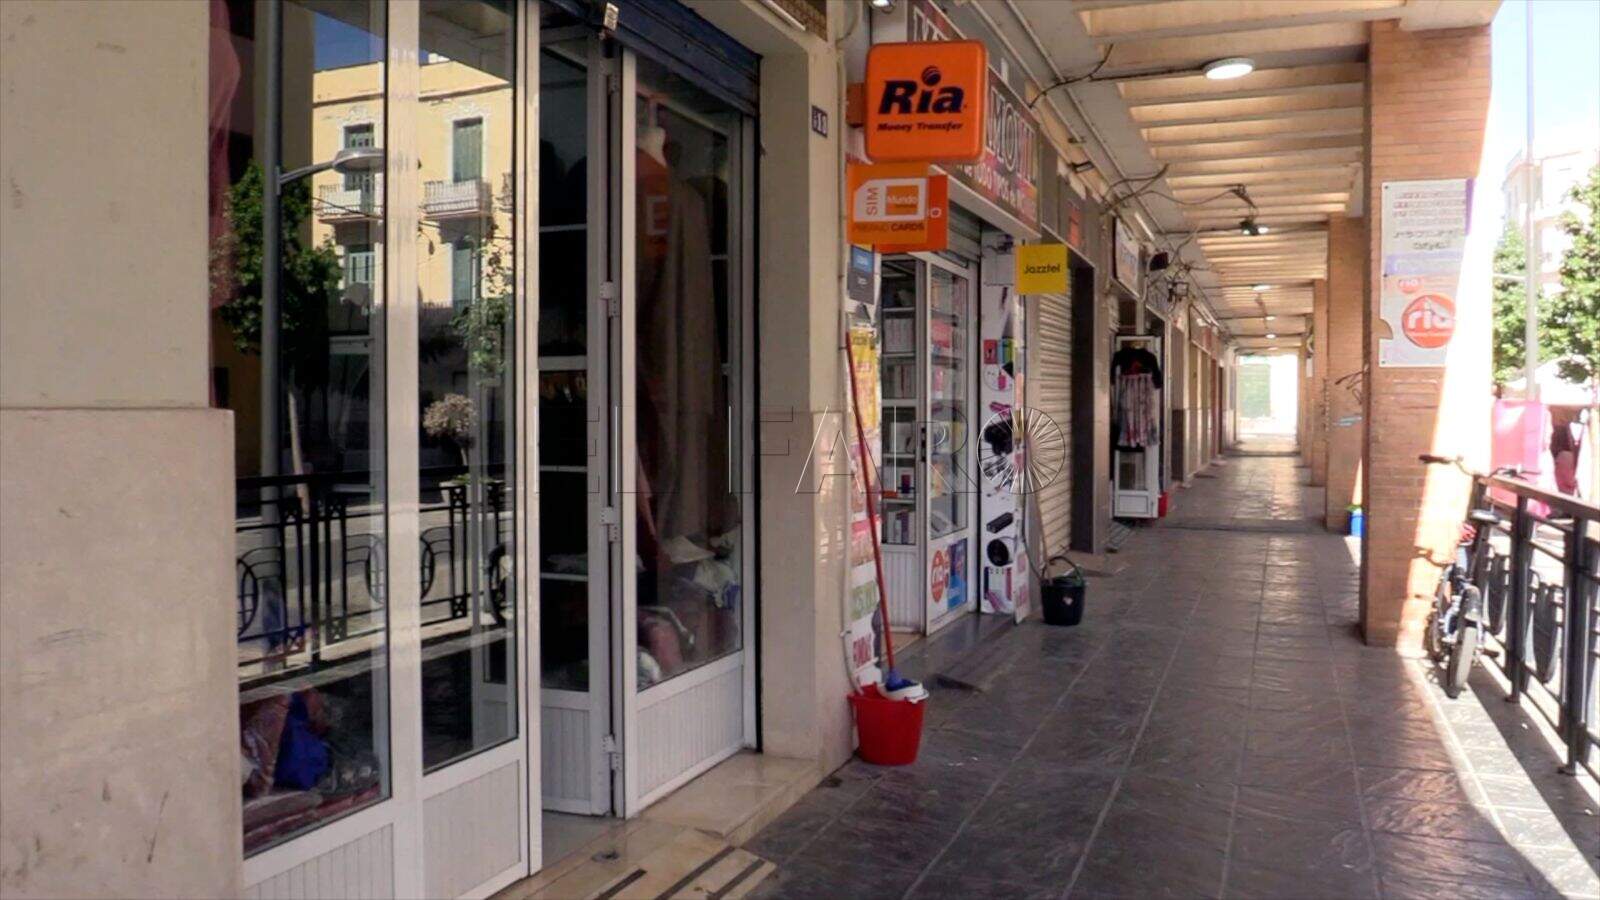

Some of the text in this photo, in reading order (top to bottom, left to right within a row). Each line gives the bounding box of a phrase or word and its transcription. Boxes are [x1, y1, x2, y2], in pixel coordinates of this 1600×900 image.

[878, 65, 964, 114] Ria
[877, 120, 963, 132] Money Transfer
[865, 187, 880, 216] SIM
[890, 222, 925, 232] CARDS
